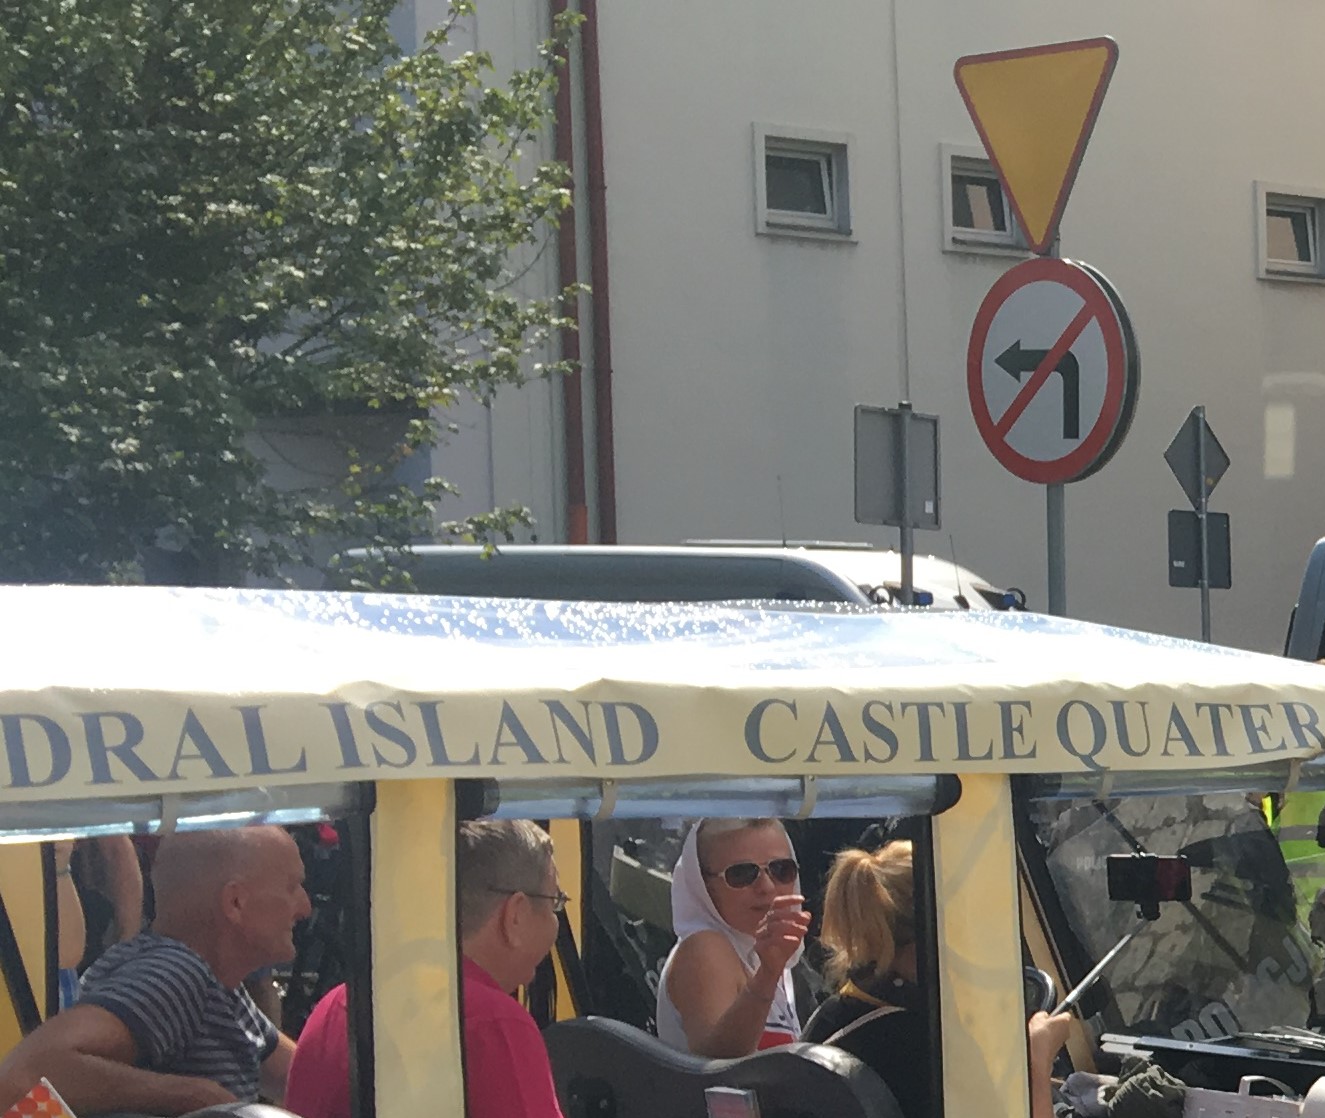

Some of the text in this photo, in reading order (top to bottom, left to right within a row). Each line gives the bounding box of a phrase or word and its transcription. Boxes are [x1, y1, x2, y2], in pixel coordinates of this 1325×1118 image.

[0, 705, 308, 790] DRAL
[320, 698, 661, 770] ISLAND
[743, 697, 1039, 765] CASTLE
